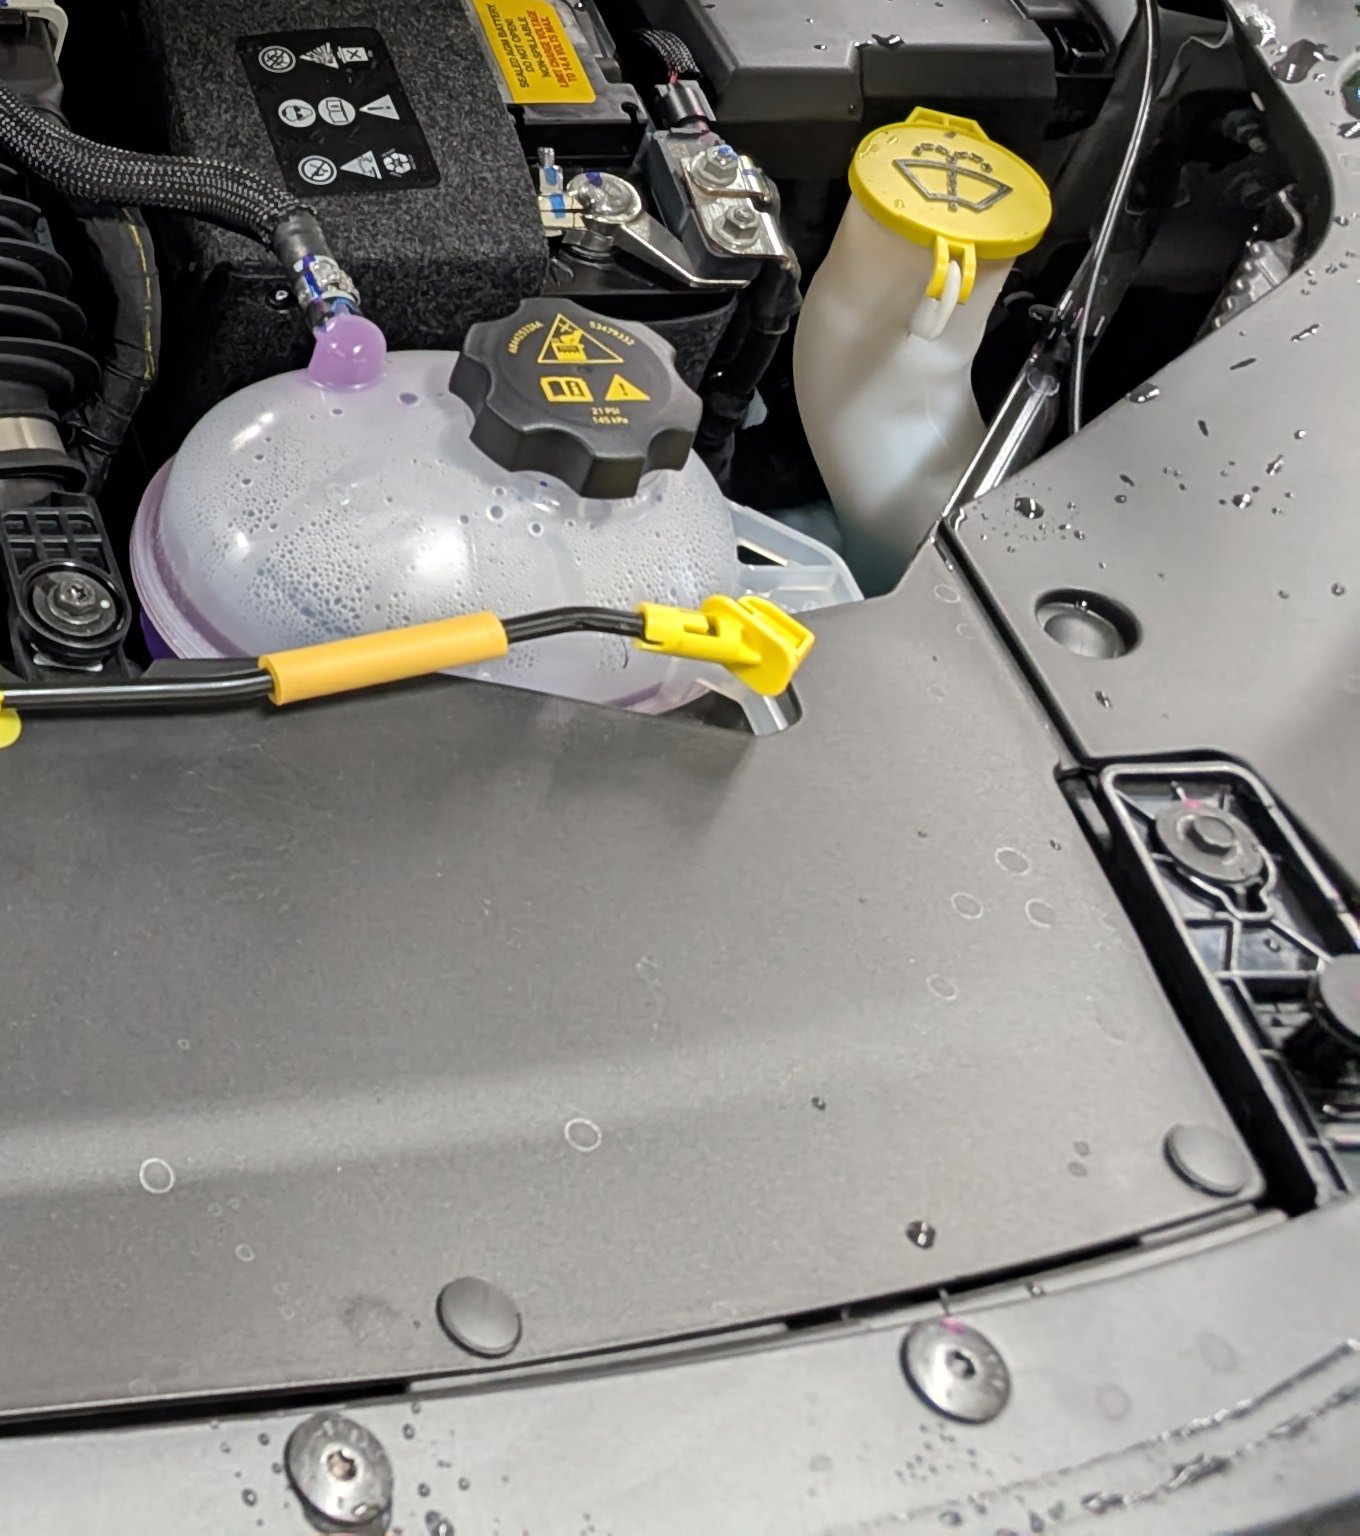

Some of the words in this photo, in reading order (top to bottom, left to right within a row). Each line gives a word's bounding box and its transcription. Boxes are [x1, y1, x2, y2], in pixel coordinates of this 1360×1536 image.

[486, 3, 507, 38] BATTERY
[501, 39, 514, 56] AGM
[515, 45, 528, 59] NOT
[517, 16, 551, 77] NON-SPILLABLE
[509, 58, 529, 87] SEALED
[522, 61, 534, 72] DO
[566, 72, 577, 81] TO
[604, 406, 621, 415] PSI
